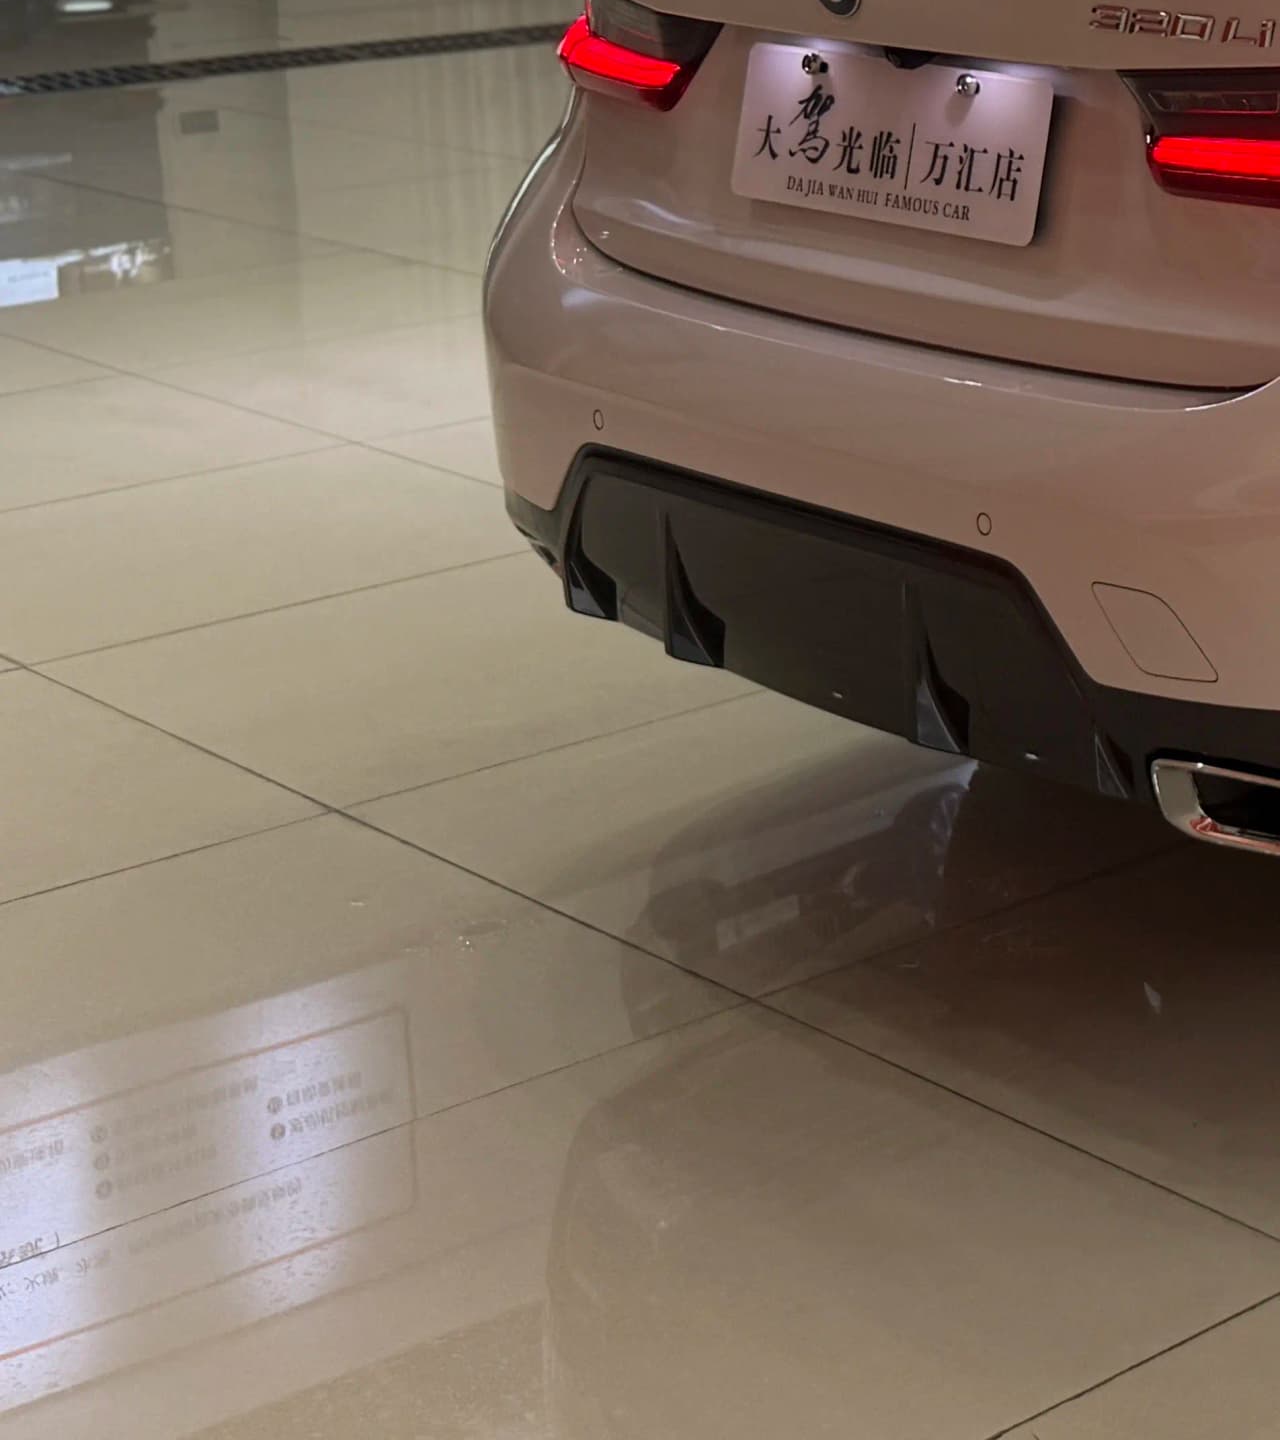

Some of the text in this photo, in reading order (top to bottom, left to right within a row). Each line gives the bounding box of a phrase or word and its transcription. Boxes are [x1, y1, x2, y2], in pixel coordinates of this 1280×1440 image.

[786, 175, 971, 221] DA JIA WAN HUI FAMOUS CAR
[920, 140, 1025, 202] 万汇店
